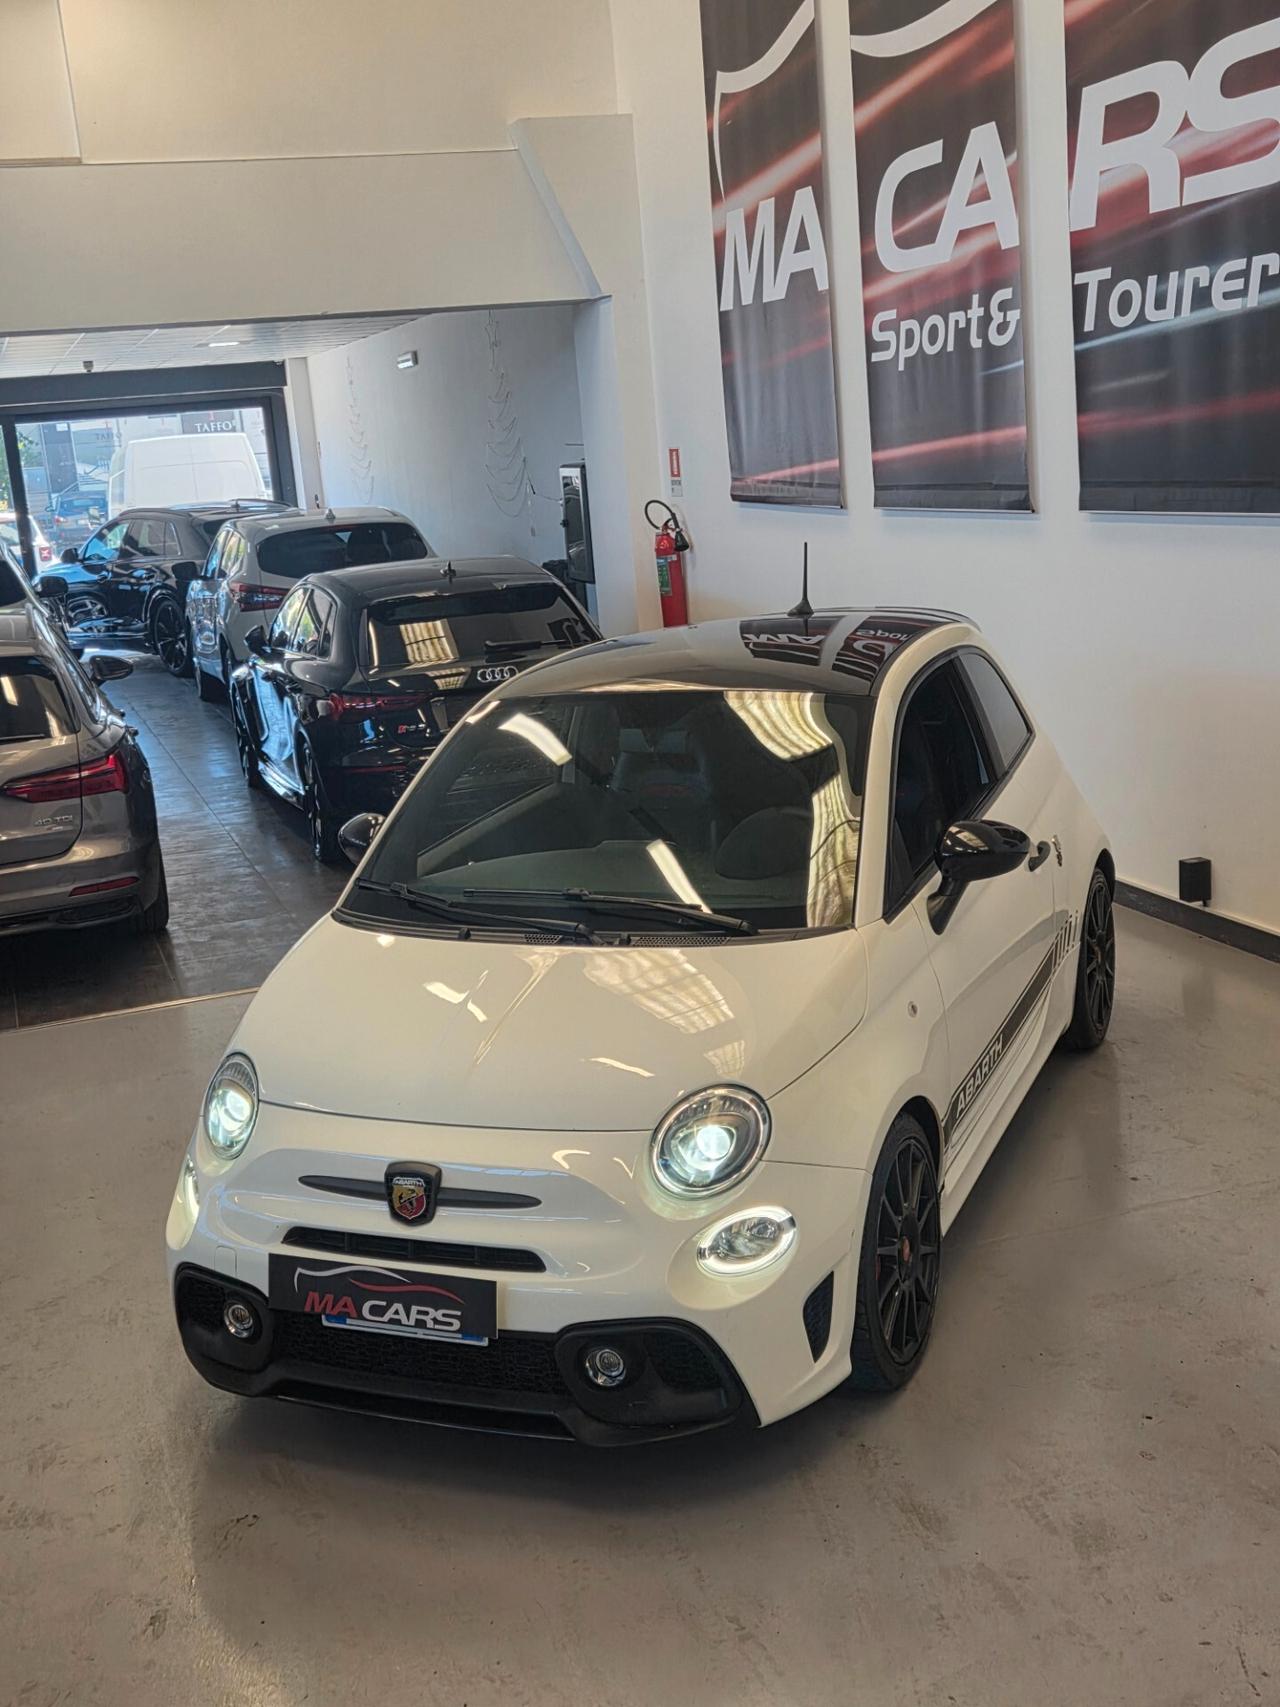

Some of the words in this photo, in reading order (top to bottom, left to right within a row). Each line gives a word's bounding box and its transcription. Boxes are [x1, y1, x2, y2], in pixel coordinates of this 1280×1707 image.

[719, 186, 829, 312] MA
[194, 421, 232, 433] TAFFO
[956, 1034, 1003, 1119] ABARTH
[303, 1291, 358, 1318] MA
[361, 1300, 462, 1331] CARS
